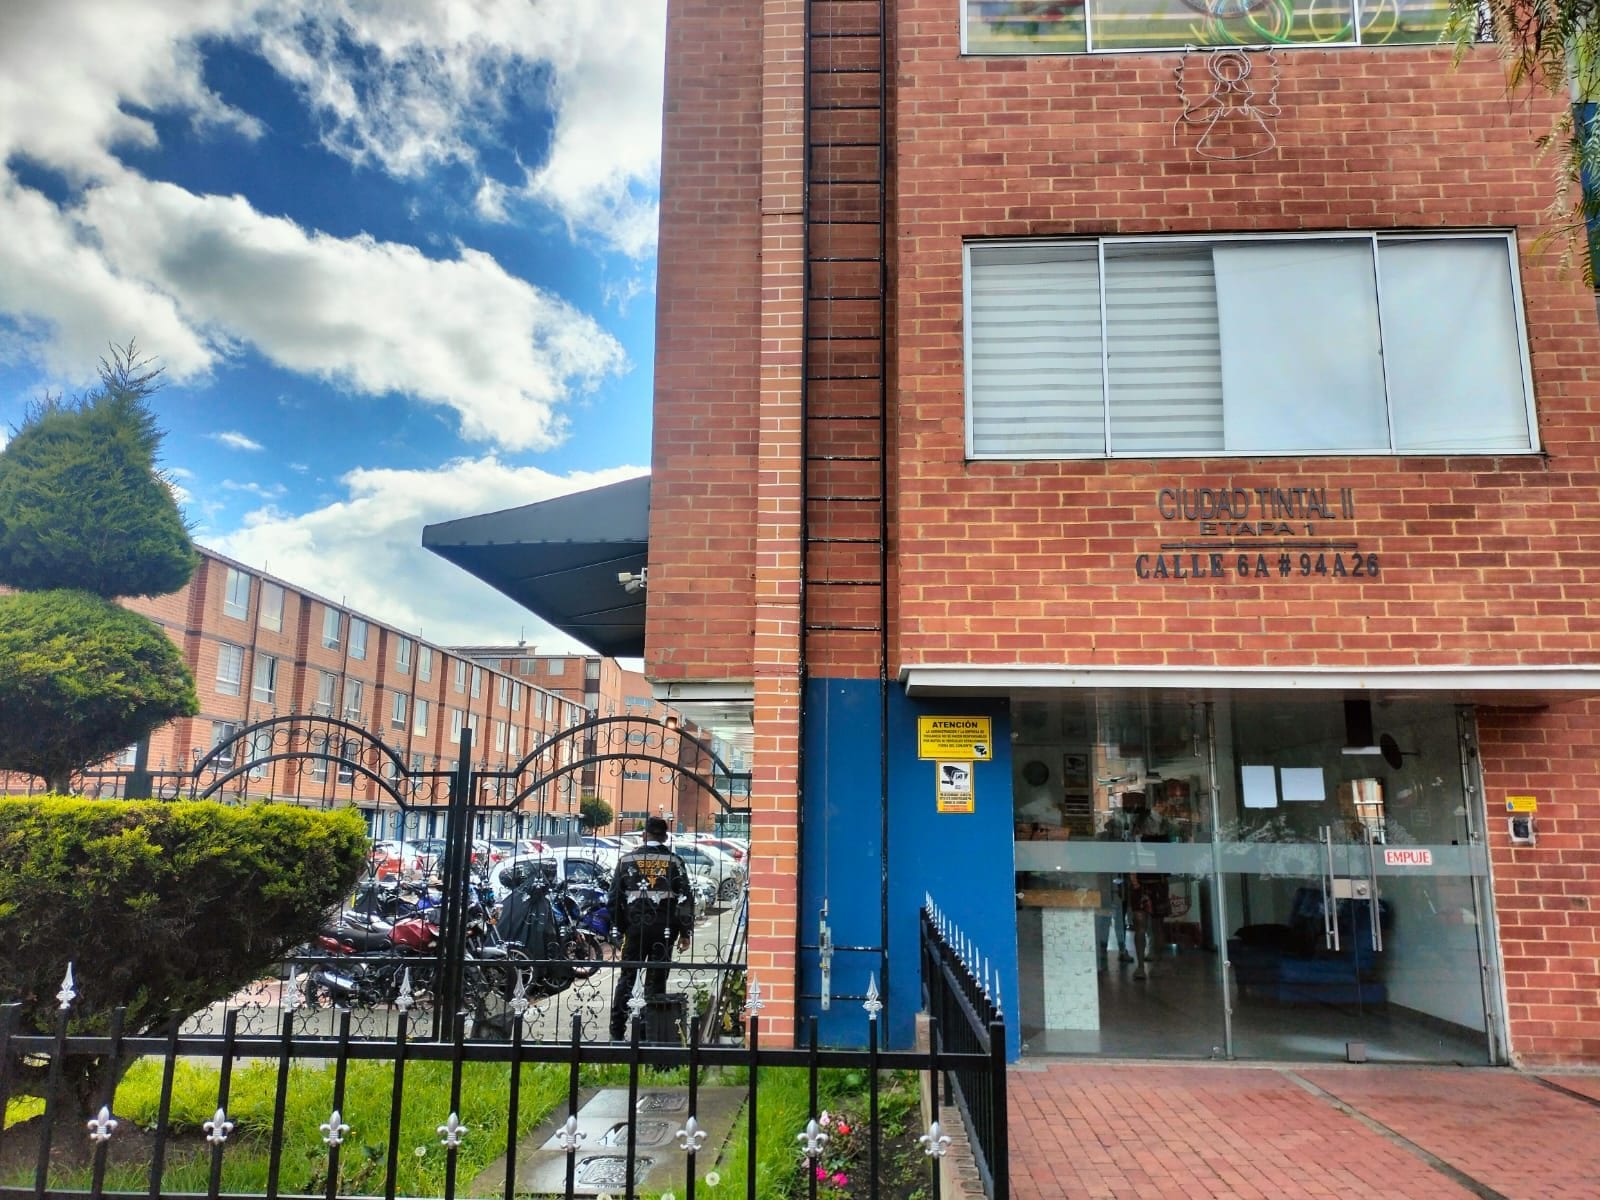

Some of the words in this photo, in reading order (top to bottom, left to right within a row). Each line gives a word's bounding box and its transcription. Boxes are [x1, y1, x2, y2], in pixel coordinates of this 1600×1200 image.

[1158, 488, 1249, 520] CIUDAD
[1256, 488, 1336, 520] TINTAL
[1341, 487, 1355, 519] II
[1200, 522, 1295, 536] ETAPA
[1303, 523, 1315, 536] 1
[1135, 553, 1225, 579] CALLE
[1237, 553, 1270, 578] 6A
[932, 720, 978, 729] ATENCIÓN
[1387, 851, 1430, 863] EMPUJE
